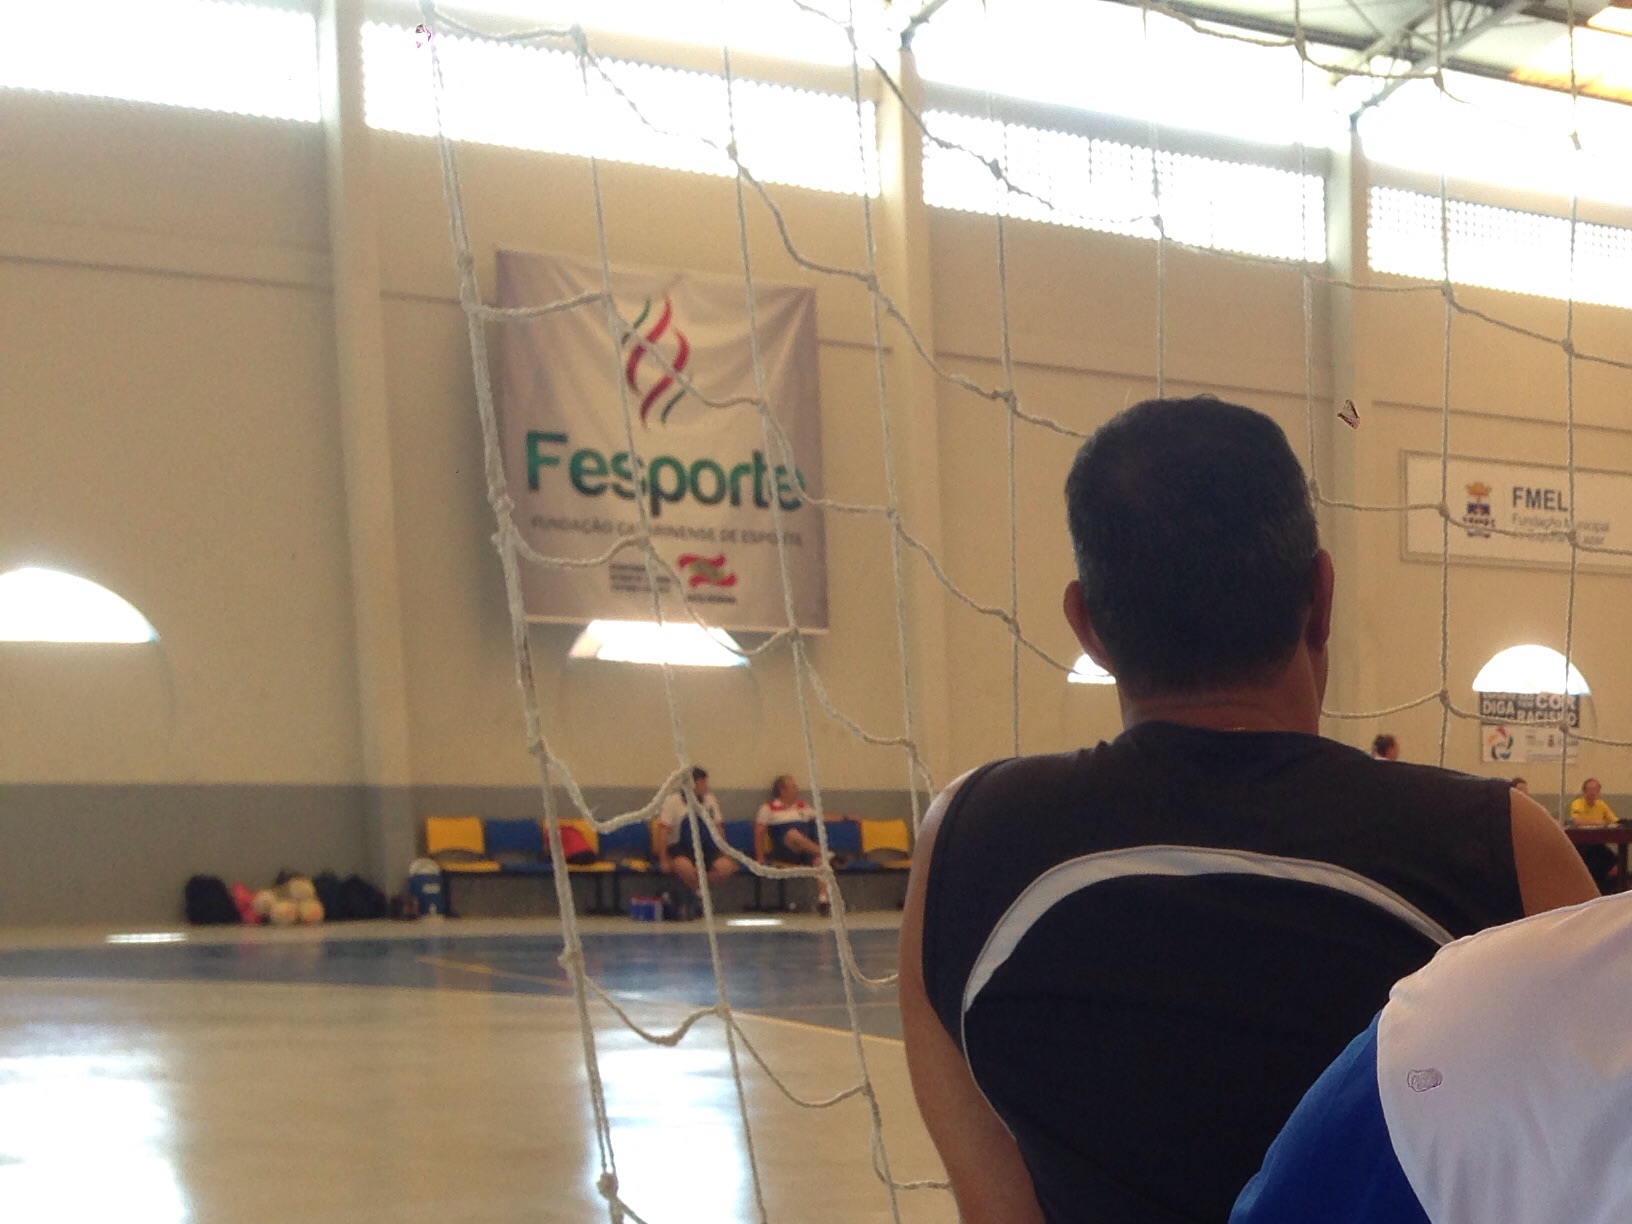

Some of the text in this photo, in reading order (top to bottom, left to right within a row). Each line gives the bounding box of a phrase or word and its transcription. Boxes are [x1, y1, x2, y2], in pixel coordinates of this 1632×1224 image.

[524, 430, 806, 517] Fesporte
[1512, 486, 1568, 511] FMEL
[617, 521, 715, 540] CAARINENSE
[1483, 700, 1515, 715] DIGA
